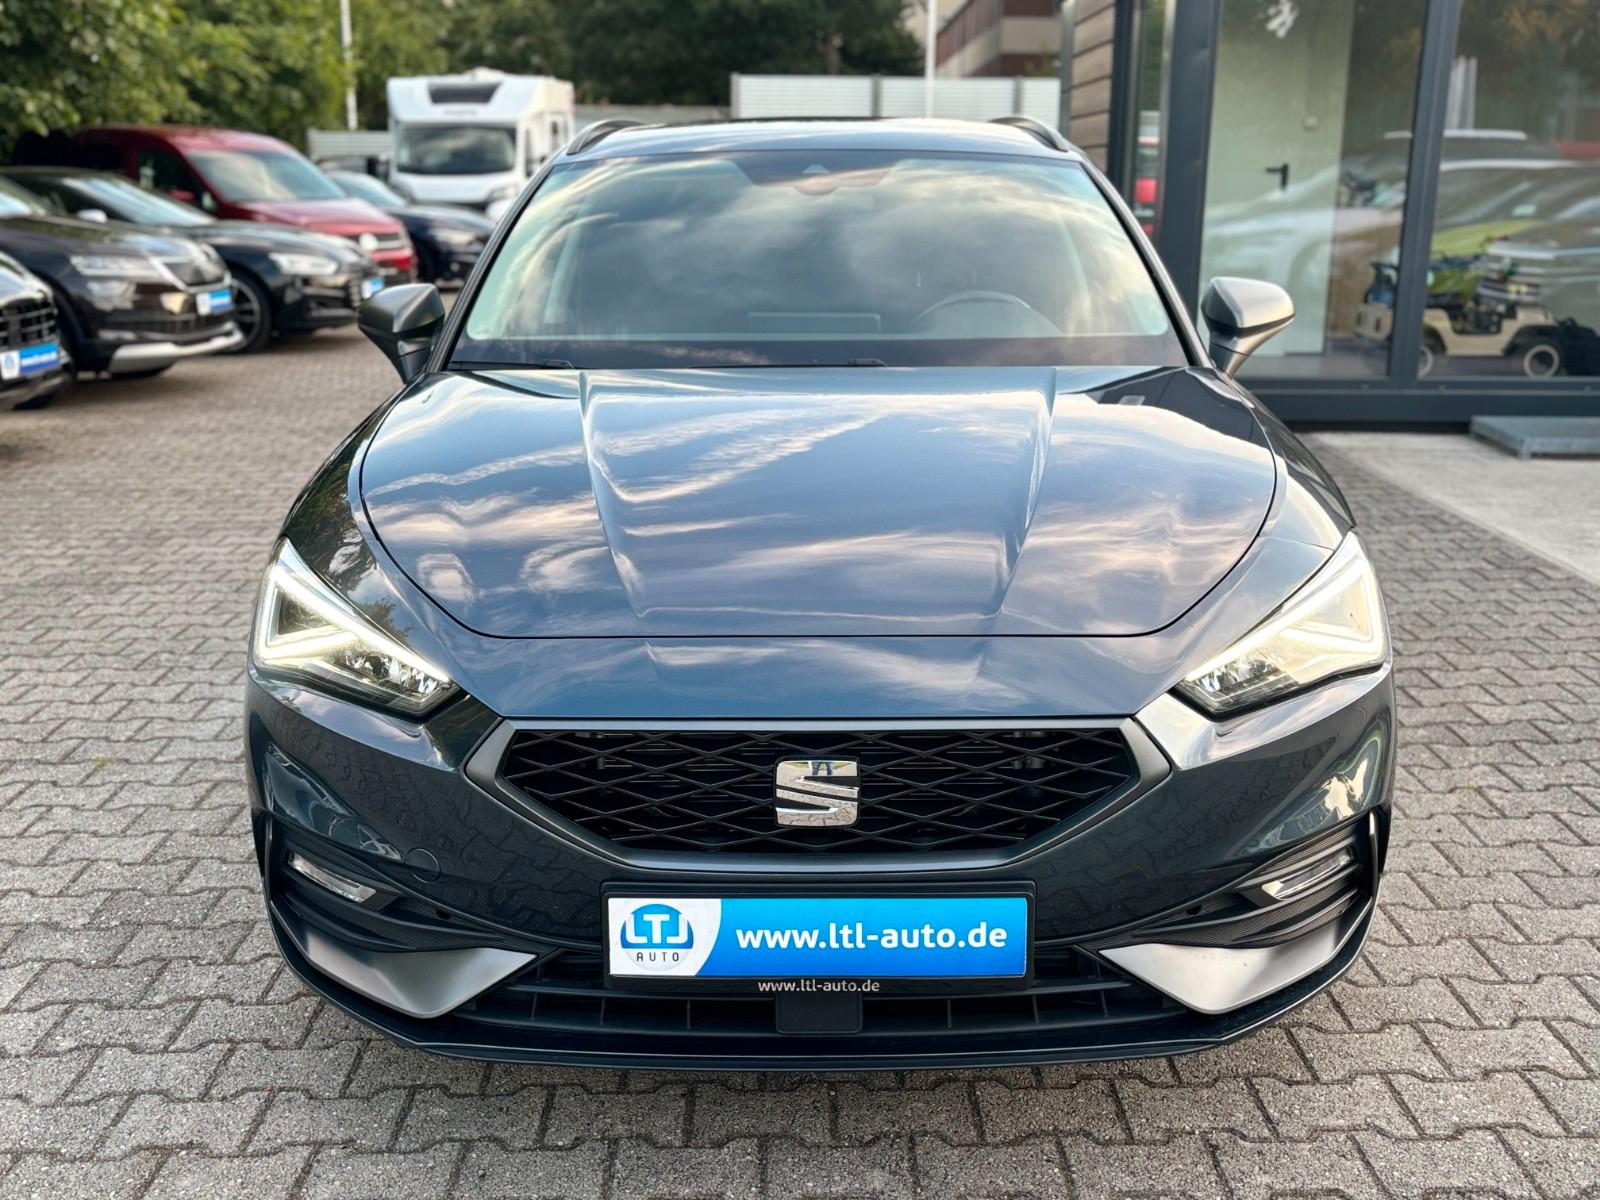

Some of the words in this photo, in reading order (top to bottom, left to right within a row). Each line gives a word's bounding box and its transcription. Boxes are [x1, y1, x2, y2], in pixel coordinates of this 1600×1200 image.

[735, 921, 1008, 949] www.ltl-auto.de
[636, 952, 680, 962] AUTO
[757, 979, 881, 992] www.ltl-auto.de
